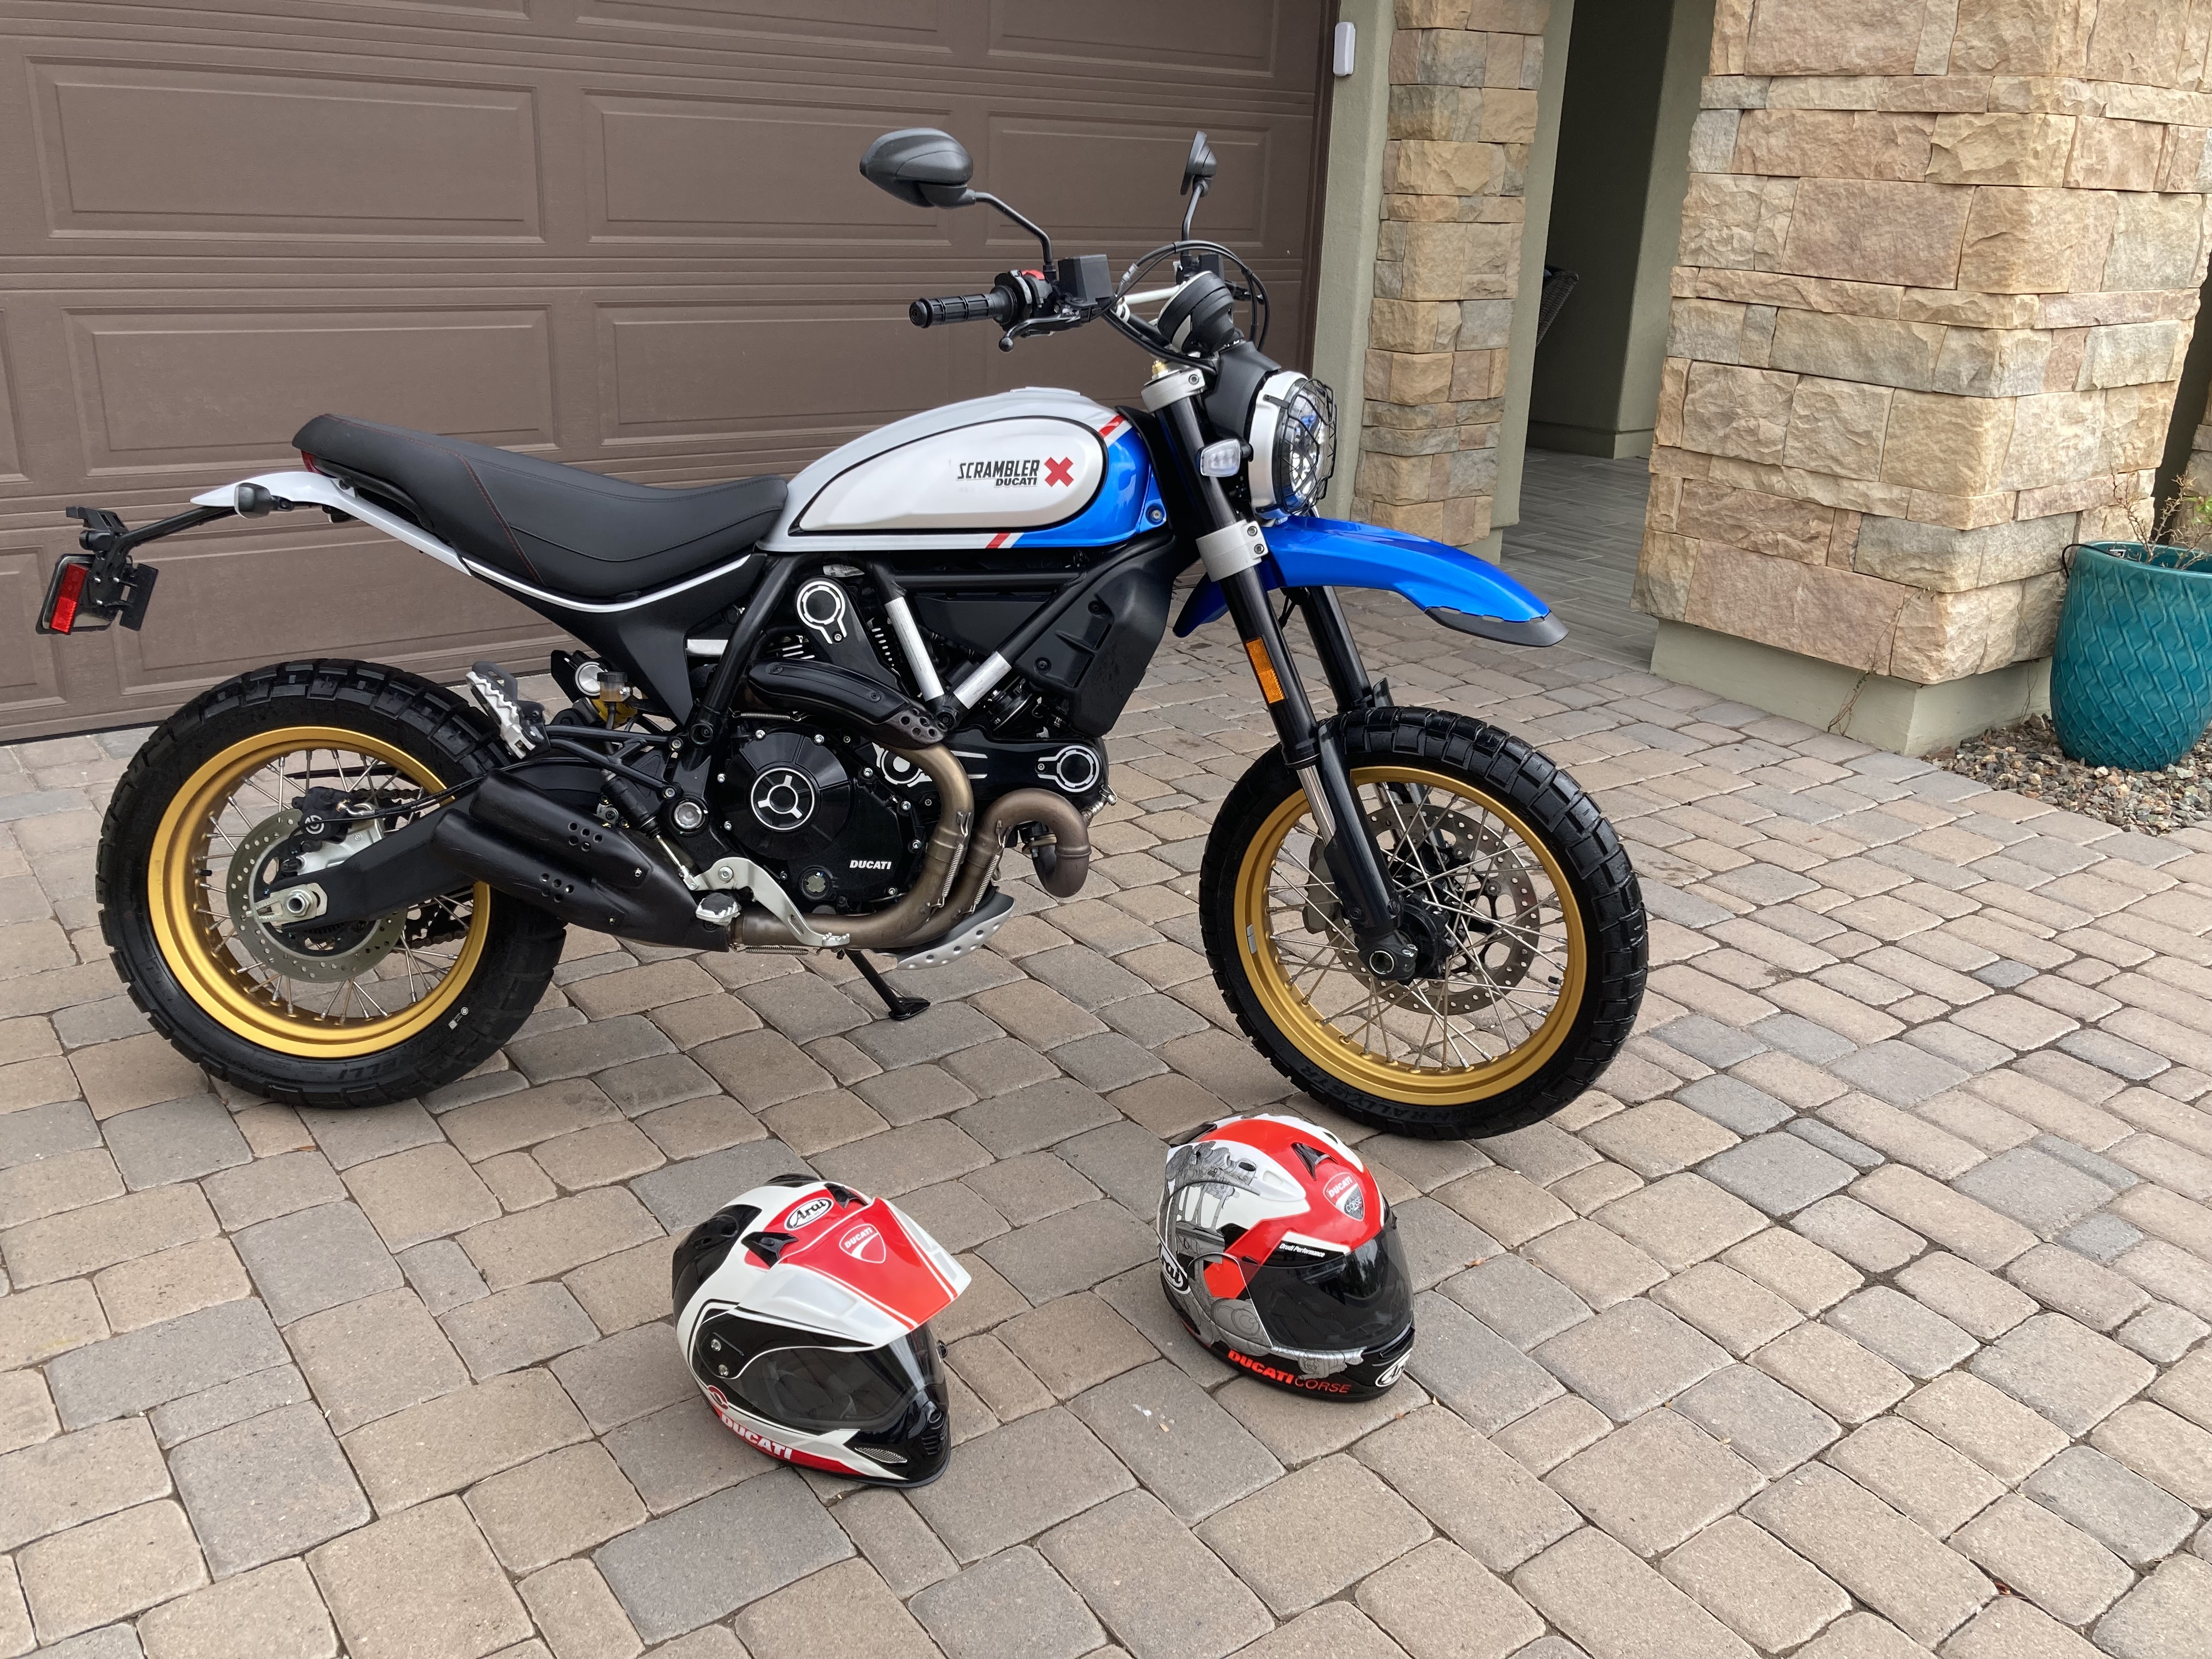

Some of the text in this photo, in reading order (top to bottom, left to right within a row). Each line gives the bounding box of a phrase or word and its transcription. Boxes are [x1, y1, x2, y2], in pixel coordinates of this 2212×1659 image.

[957, 460, 1040, 480] SCRAMBLER
[995, 477, 1037, 487] DUCATI
[849, 860, 892, 870] DUCATI
[1328, 1176, 1353, 1198] DUCATI
[793, 1200, 826, 1227] Arai
[1346, 1196, 1362, 1212] CORSE
[844, 1227, 873, 1249] DUCATI
[1279, 1243, 1325, 1258] Drudi Performance
[1228, 1349, 1352, 1393] DUCATI CORSE
[721, 1413, 793, 1460] DUCATI
